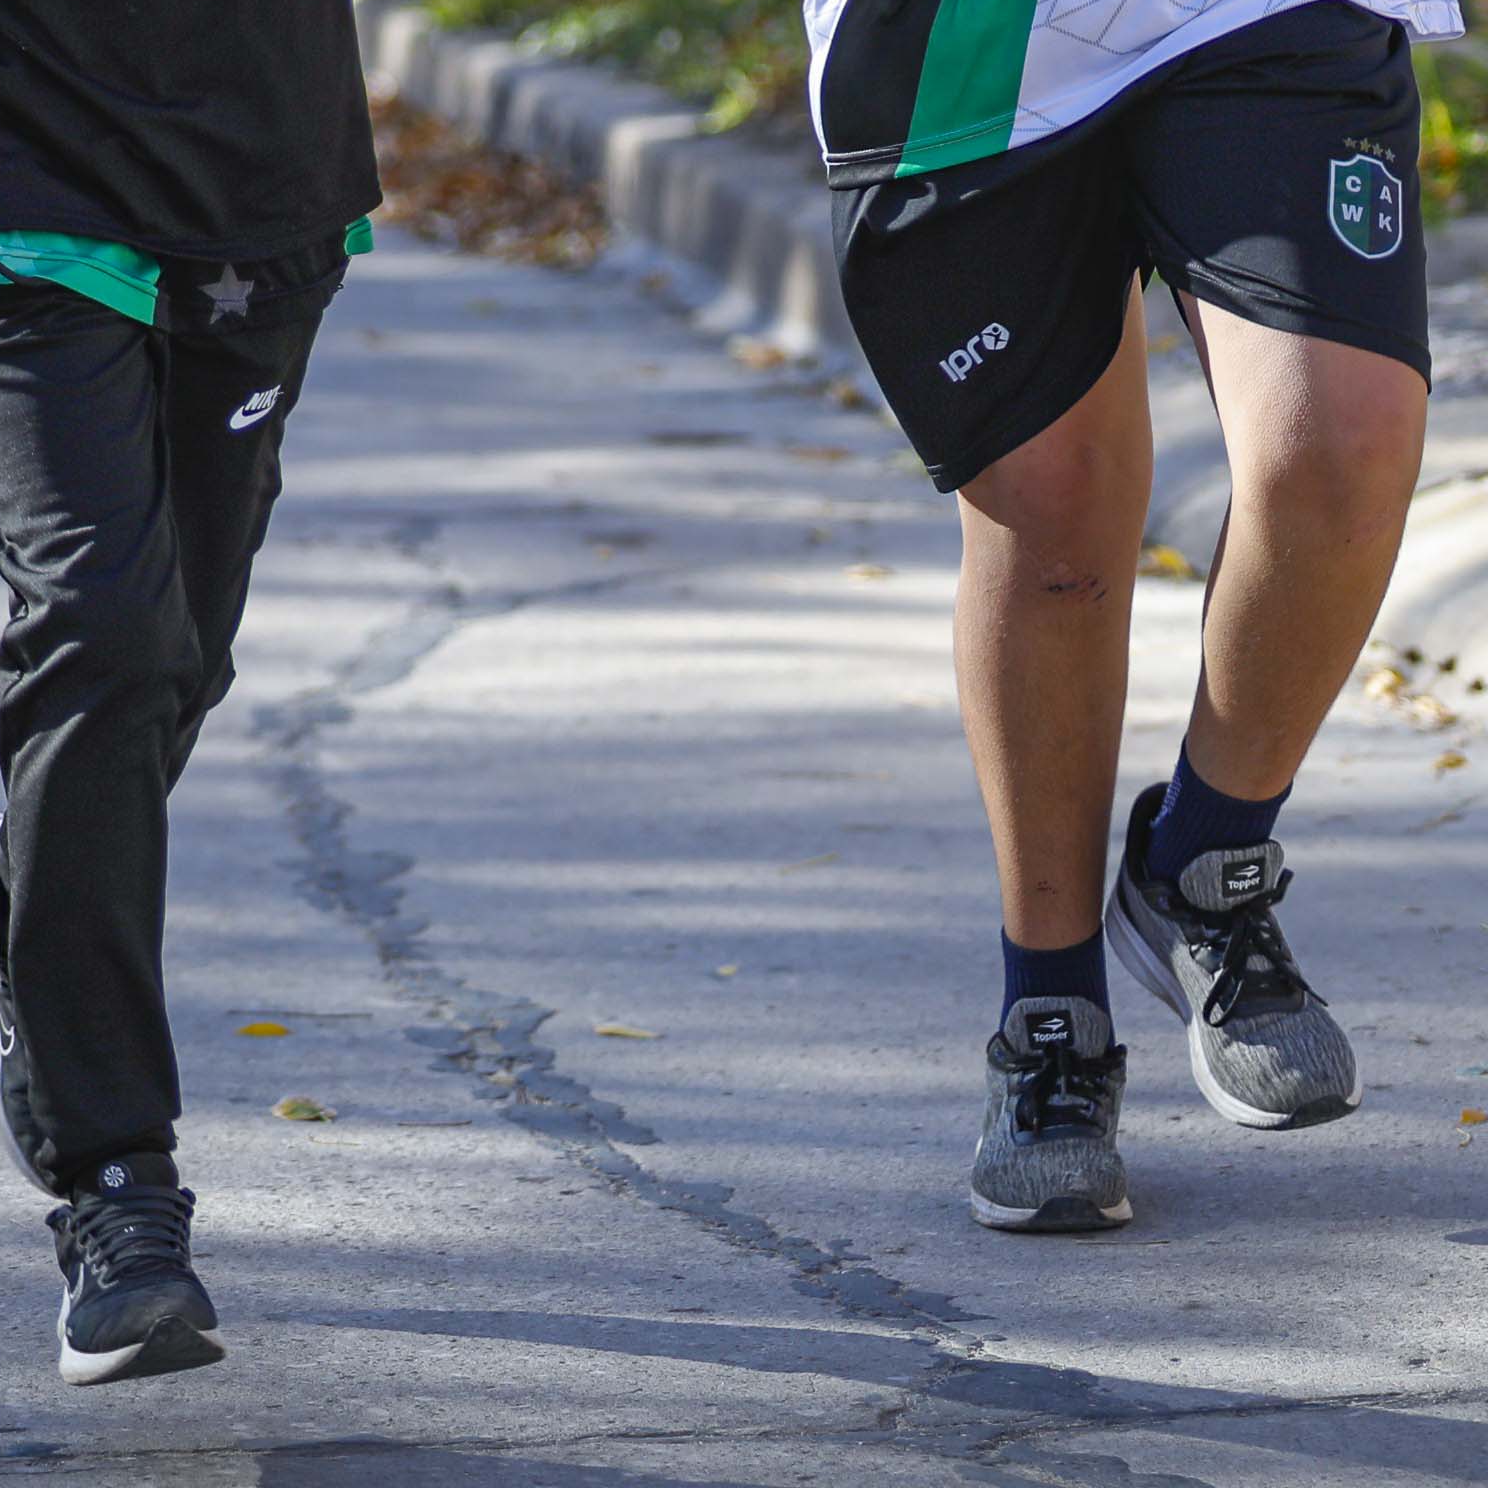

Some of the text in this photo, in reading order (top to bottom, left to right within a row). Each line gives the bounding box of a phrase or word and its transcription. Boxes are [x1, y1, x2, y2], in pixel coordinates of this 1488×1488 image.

[1345, 175, 1393, 204] C A
[1341, 203, 1392, 233] W K
[1227, 876, 1261, 891] Topper
